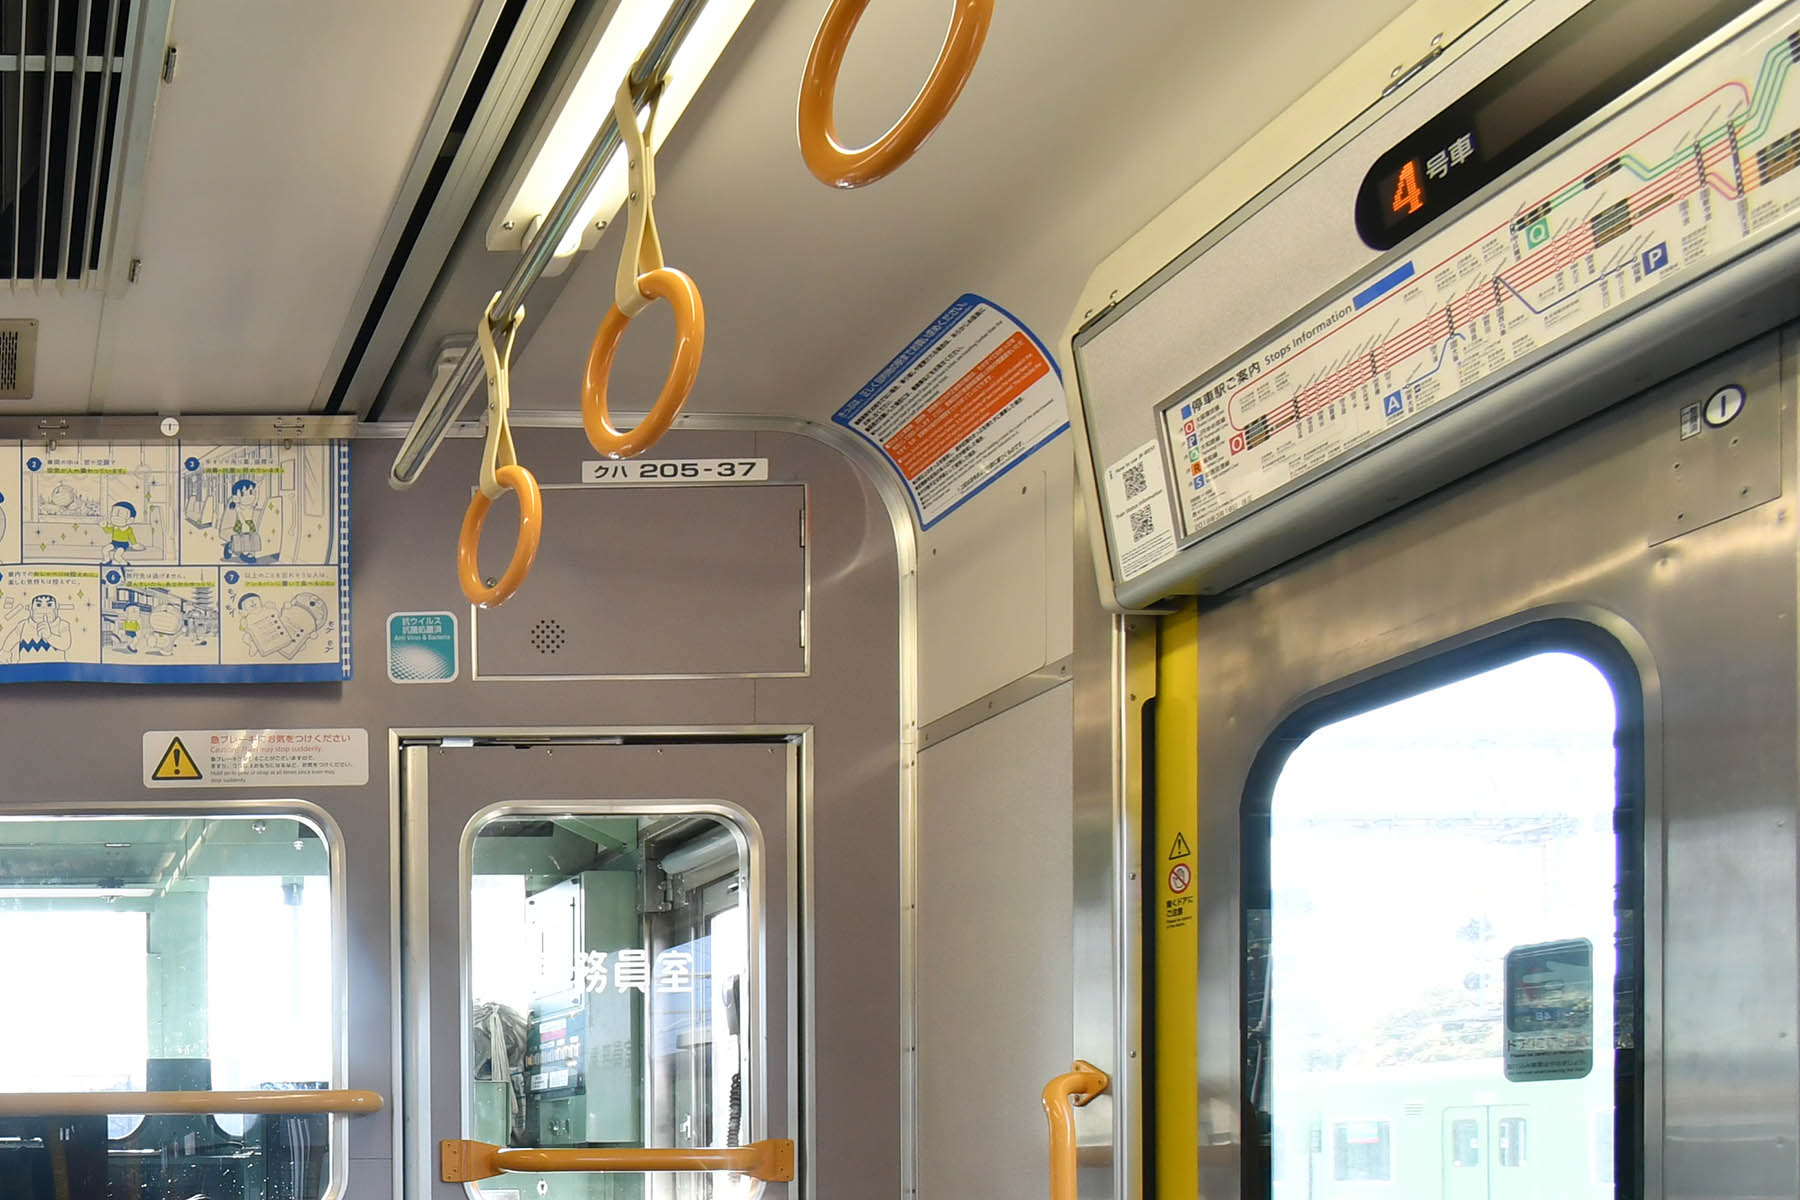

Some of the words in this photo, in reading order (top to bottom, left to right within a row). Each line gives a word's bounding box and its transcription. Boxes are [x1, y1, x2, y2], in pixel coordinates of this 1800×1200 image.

[1391, 159, 1425, 215] 4
[1426, 131, 1476, 181] 号車
[1190, 361, 1262, 414] 停車駅ご案内
[1263, 343, 1292, 367] Stops
[1292, 306, 1353, 348] Information
[594, 465, 628, 479] クハ
[639, 462, 757, 479] 205-37
[402, 616, 442, 626] 抗ウイルス
